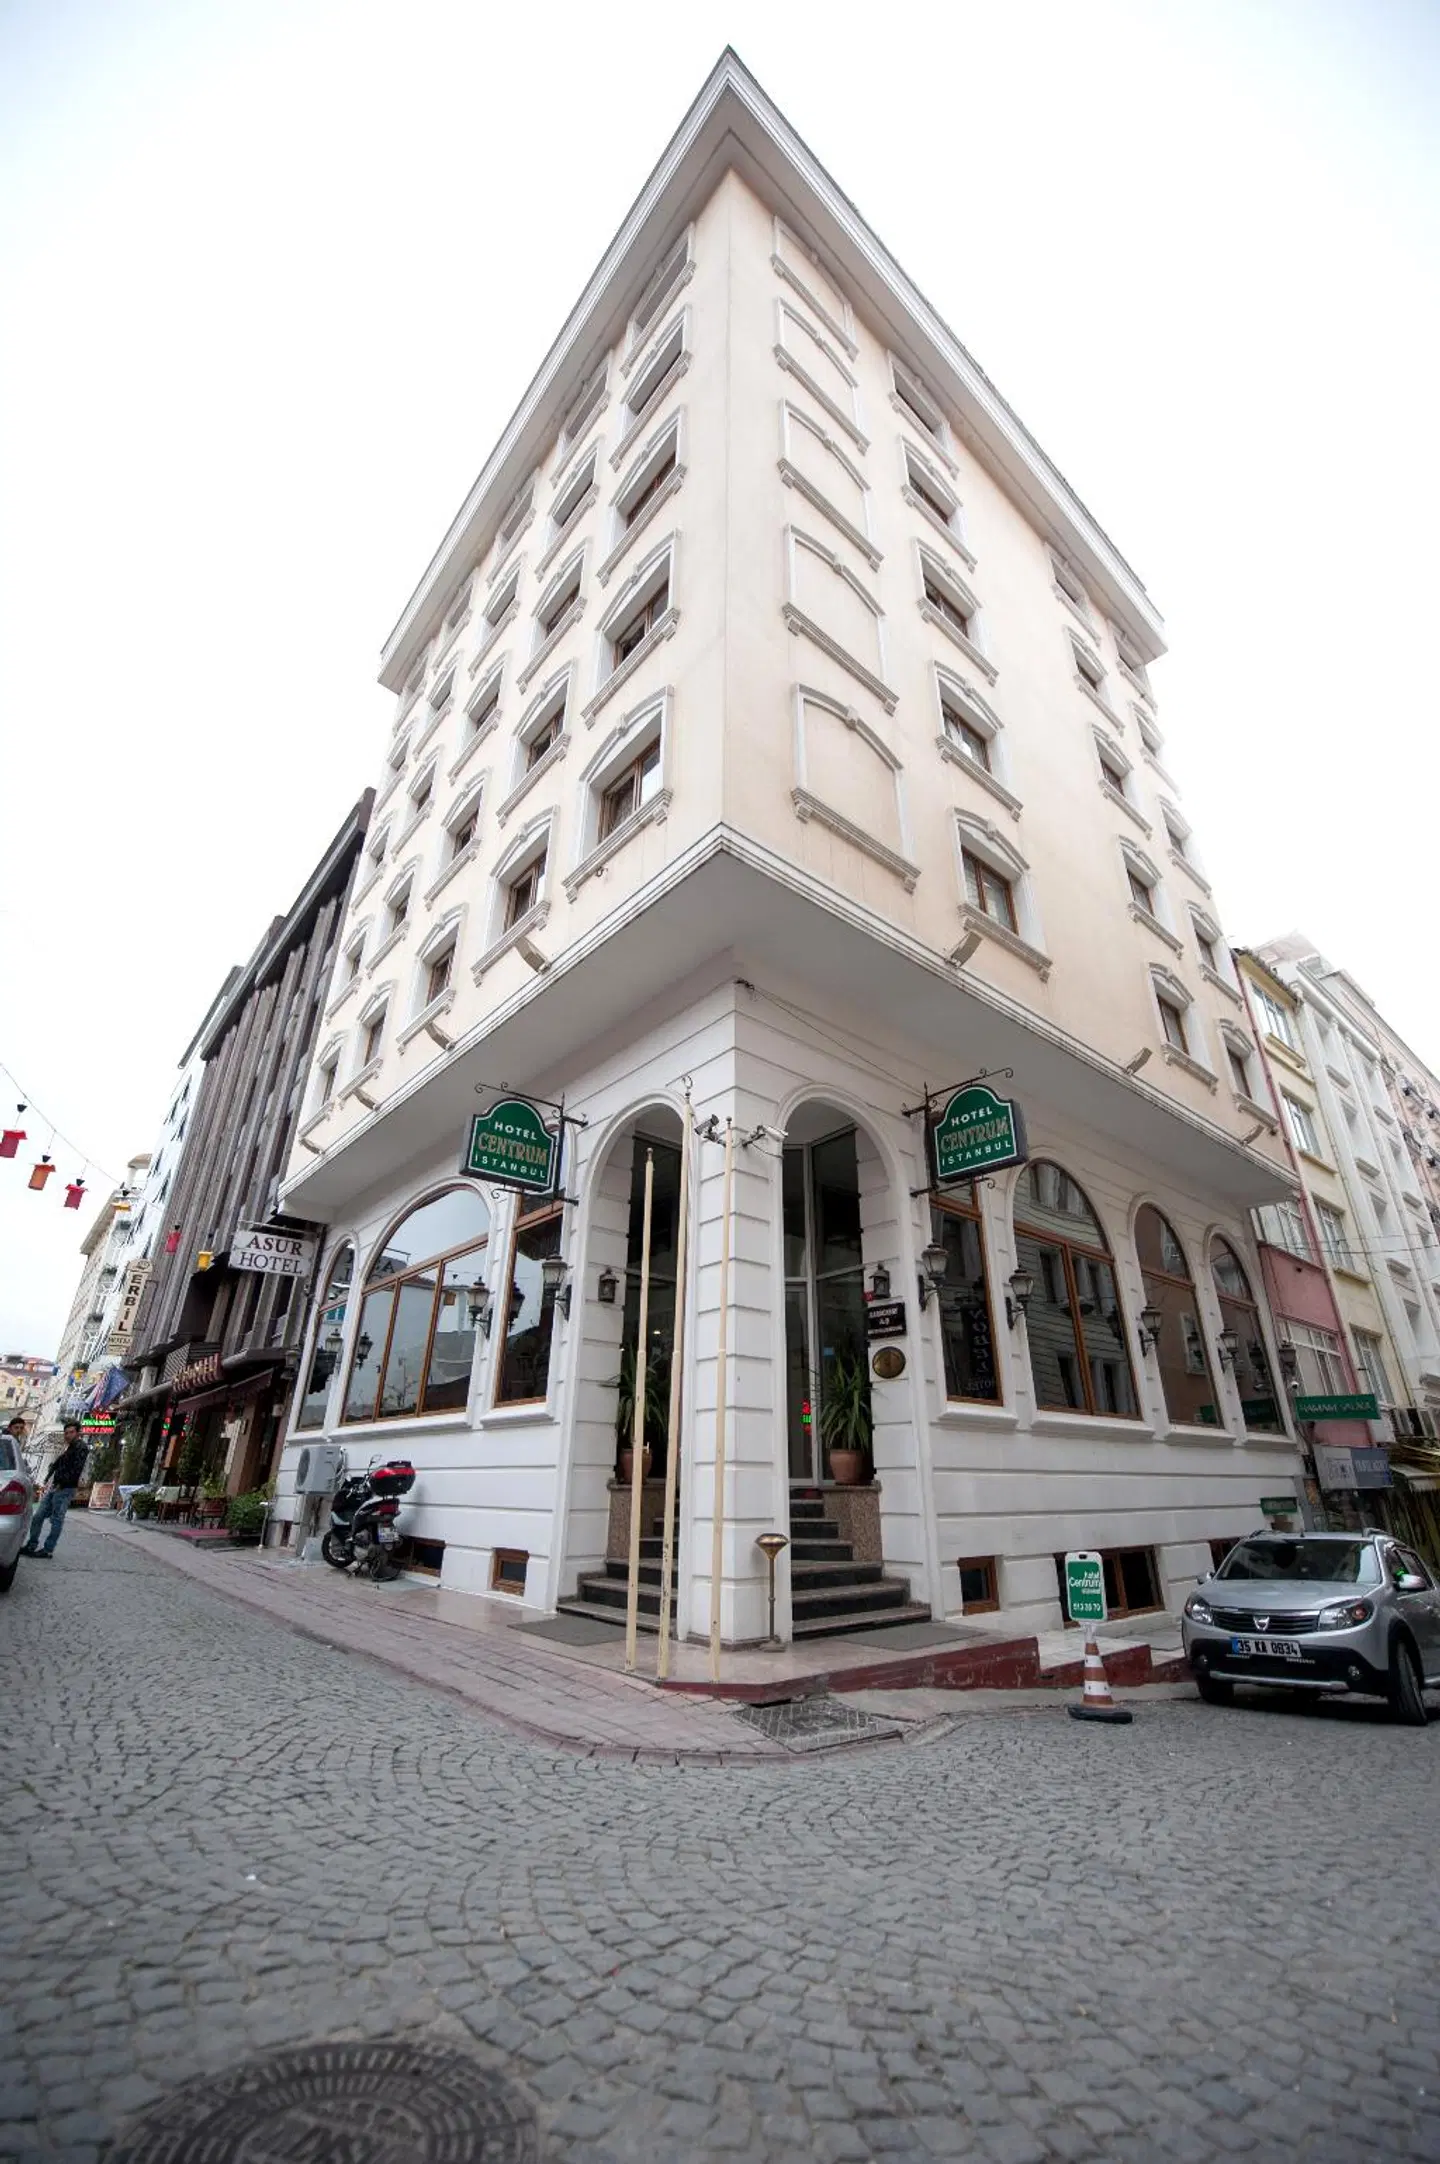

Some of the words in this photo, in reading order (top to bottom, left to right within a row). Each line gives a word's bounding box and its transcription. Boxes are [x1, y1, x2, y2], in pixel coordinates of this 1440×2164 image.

[951, 1106, 993, 1126] HOTEL
[494, 1121, 537, 1140] HOTEL
[940, 1115, 1010, 1152] CENTRUM
[478, 1131, 548, 1166] CENTRUM
[246, 1234, 302, 1255] ASUR
[238, 1251, 303, 1274] HOTEL
